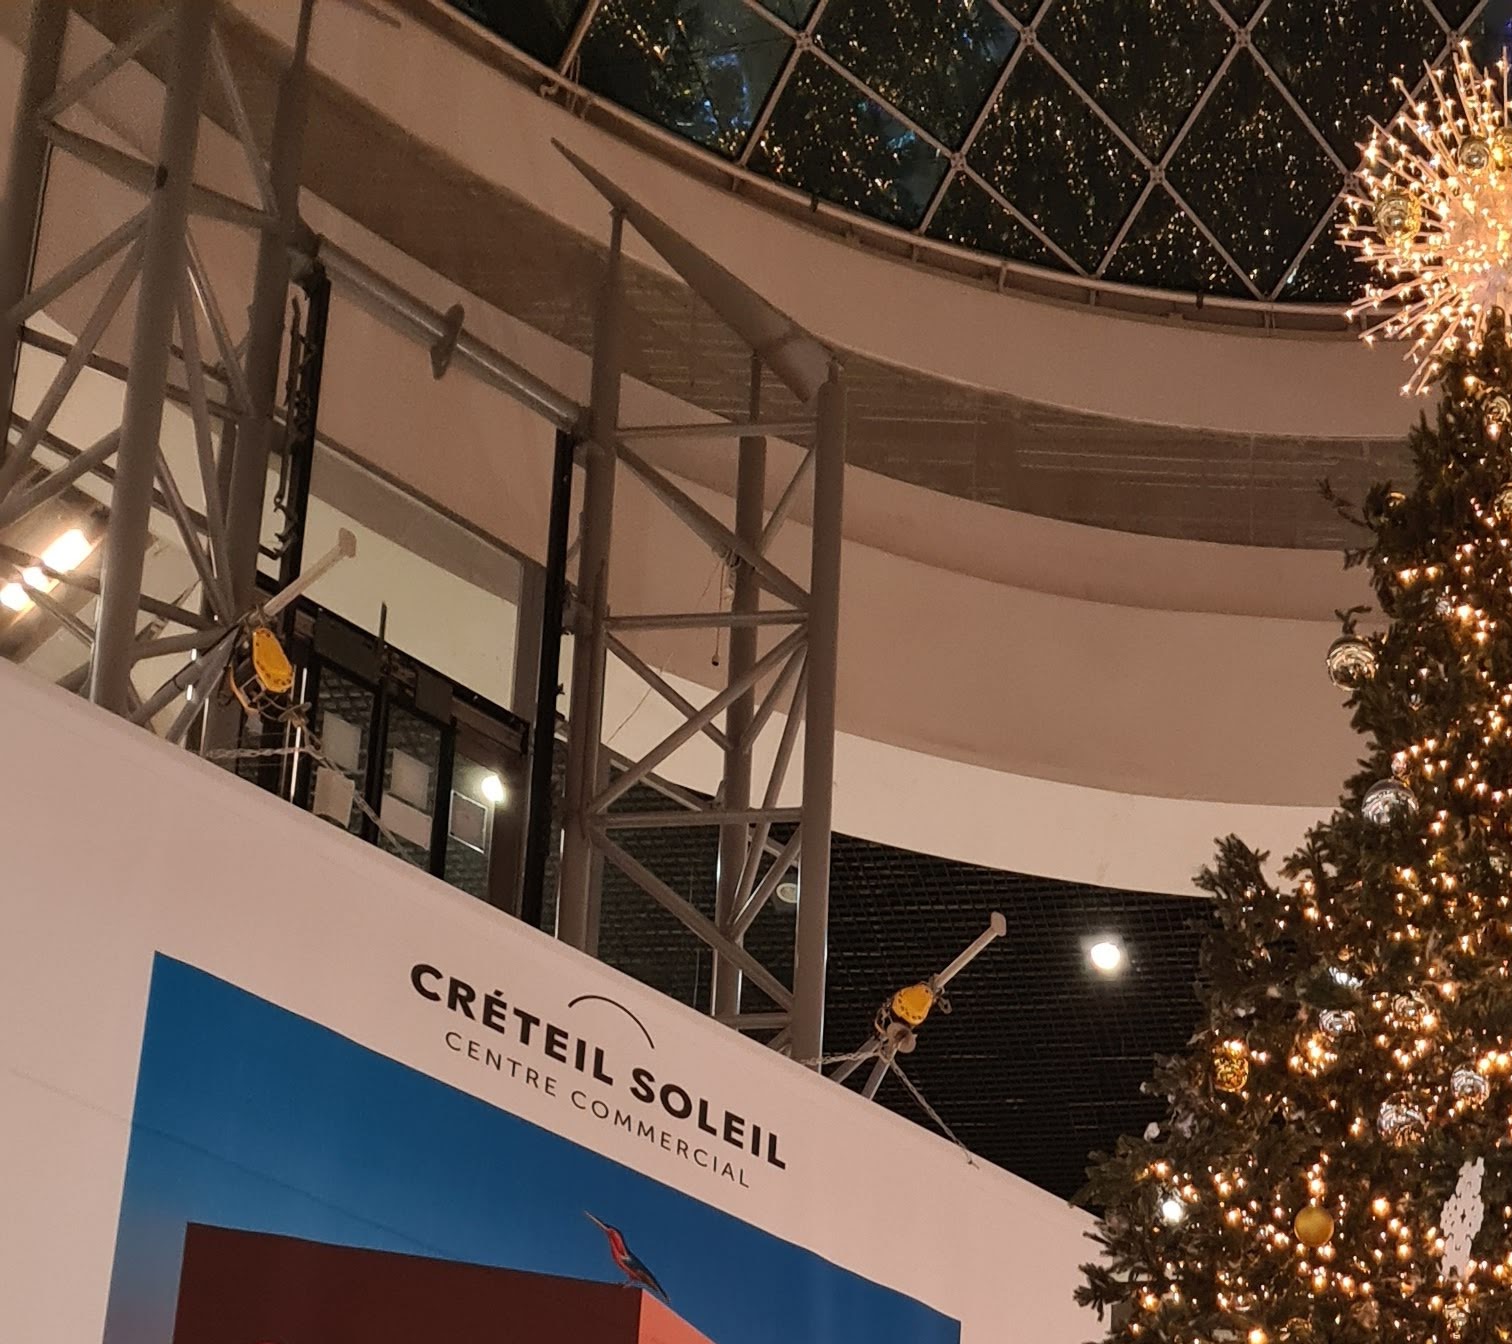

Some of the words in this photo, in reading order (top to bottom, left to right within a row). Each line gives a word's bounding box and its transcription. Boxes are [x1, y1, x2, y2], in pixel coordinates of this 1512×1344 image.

[410, 963, 614, 1086] CRÉTEIL
[630, 1067, 787, 1170] SOLEIL
[445, 1031, 557, 1097] CENTRE
[571, 1090, 750, 1189] COMMERCIAL
